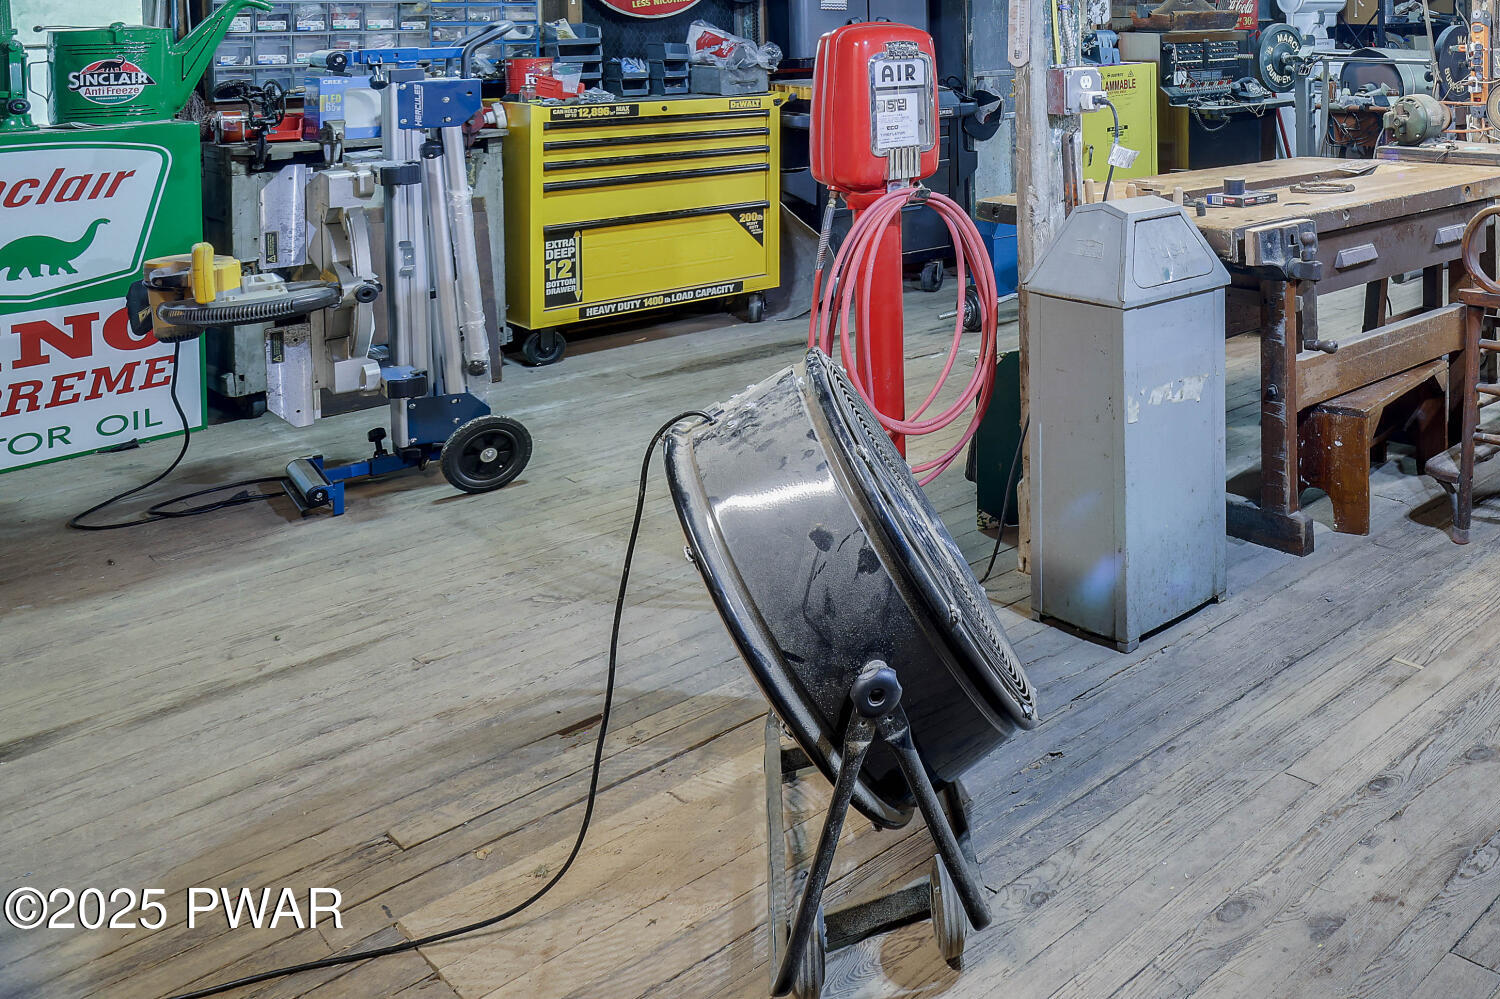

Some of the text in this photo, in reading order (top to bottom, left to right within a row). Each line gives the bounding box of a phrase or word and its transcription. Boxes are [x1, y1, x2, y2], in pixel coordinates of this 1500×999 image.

[631, 0, 651, 8] LESS
[1277, 34, 1300, 53] MARCY
[67, 71, 149, 89] SINCLAIR
[881, 64, 916, 82] AIR
[1266, 63, 1291, 83] BUMPER
[325, 94, 342, 103] LED
[413, 84, 423, 127] HERCULES
[578, 106, 610, 118] 12,896
[0, 168, 136, 209] clair
[545, 237, 575, 249] EXTRA
[545, 247, 575, 260] DEEP
[545, 277, 576, 289] BOTTOM
[545, 285, 576, 296] DRAWER
[586, 303, 615, 317] HEAVY
[617, 300, 641, 312] DUTY
[643, 296, 664, 307] 1400
[671, 291, 694, 302] LOAD
[695, 283, 735, 299] CAPACITY
[0, 306, 160, 371] NO
[0, 355, 175, 418] REME
[96, 408, 163, 436] OIL
